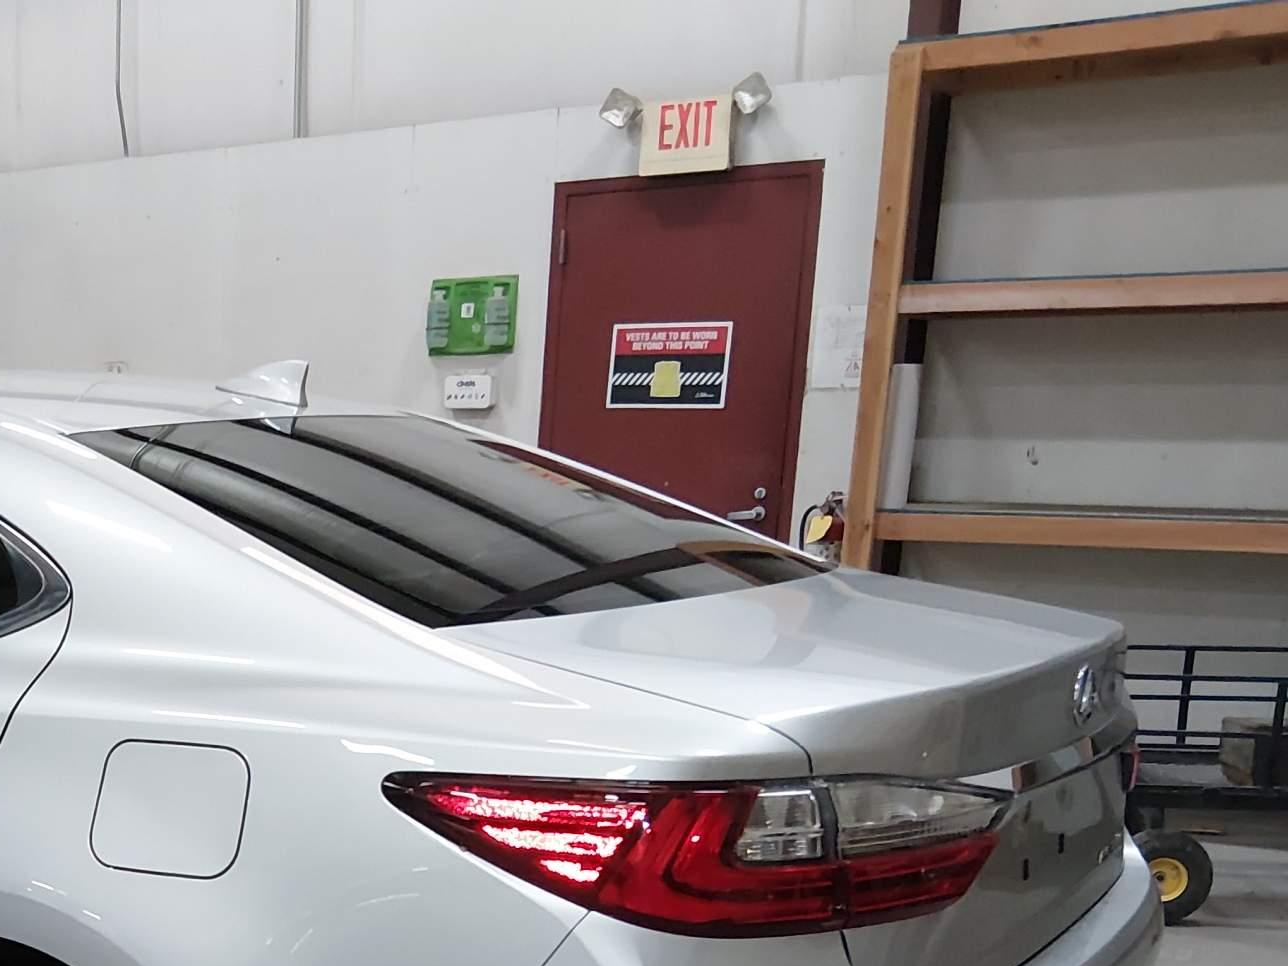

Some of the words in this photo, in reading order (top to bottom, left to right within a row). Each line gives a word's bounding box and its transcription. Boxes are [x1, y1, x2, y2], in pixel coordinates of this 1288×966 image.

[658, 100, 718, 151] EXIT
[626, 332, 650, 342] VESTS
[651, 331, 666, 341] ARE
[668, 331, 679, 341] TO
[680, 330, 692, 340] BE
[693, 330, 718, 340] WORN
[632, 341, 663, 351] BEYOND
[665, 341, 683, 350] THIS
[684, 340, 709, 350] POINT
